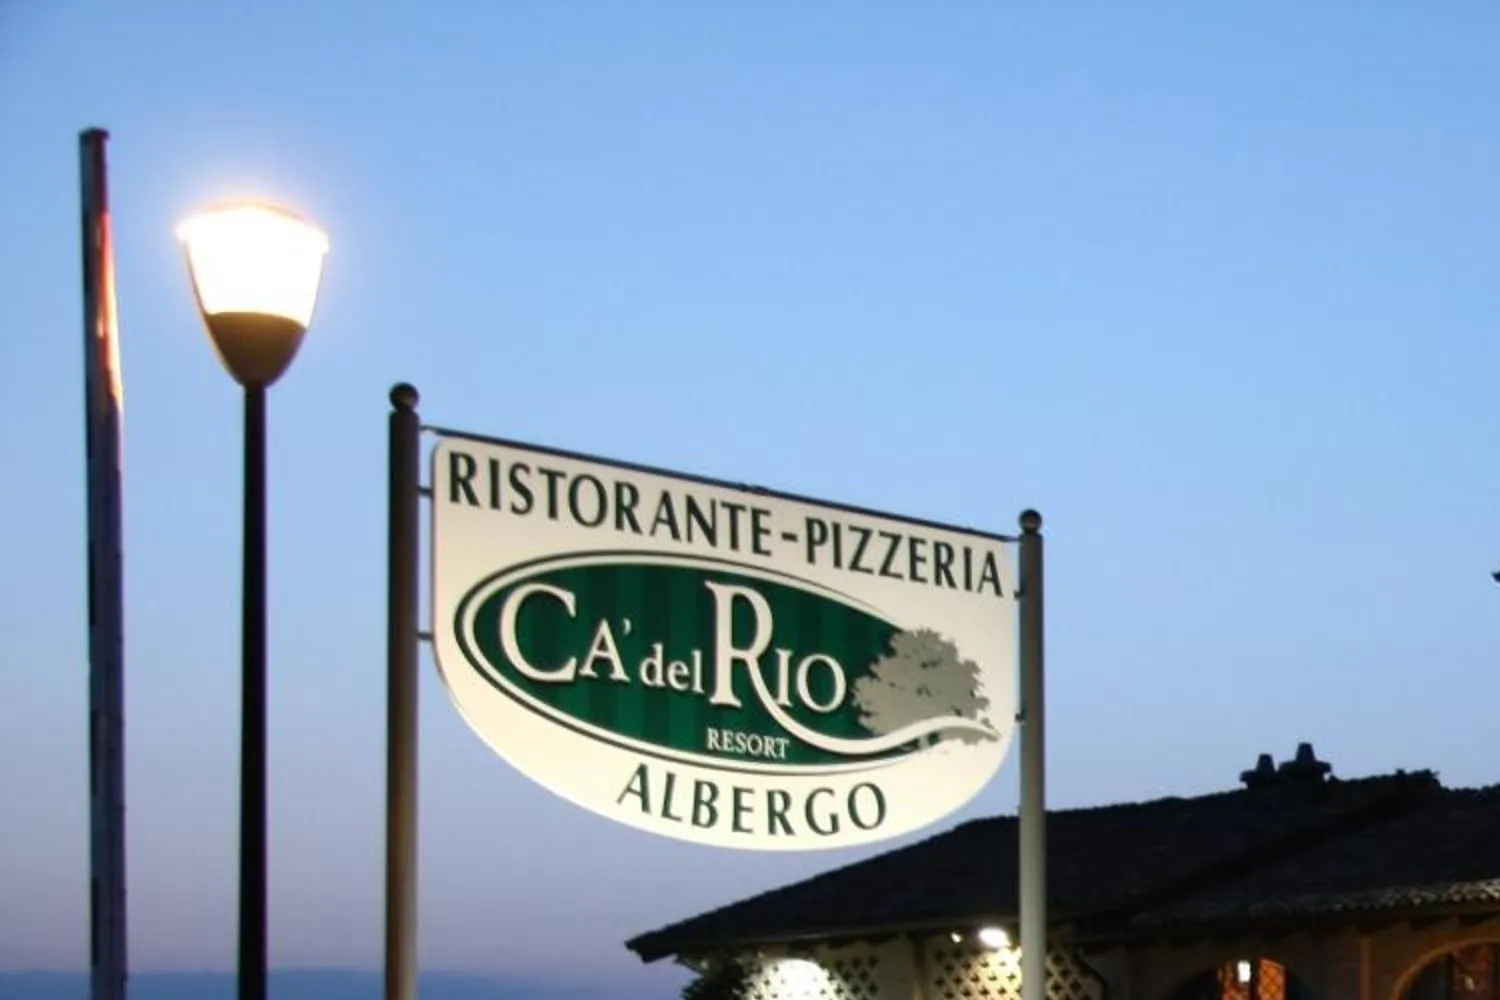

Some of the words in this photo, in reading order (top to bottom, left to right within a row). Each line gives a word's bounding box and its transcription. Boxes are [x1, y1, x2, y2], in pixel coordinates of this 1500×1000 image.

[449, 451, 1003, 597] RISTORANTE-PIZZERIA
[500, 583, 631, 683] CA'
[640, 642, 704, 694] del
[704, 580, 846, 713] RIO
[706, 727, 790, 760] RESORT
[617, 763, 886, 836] ALBERGO
